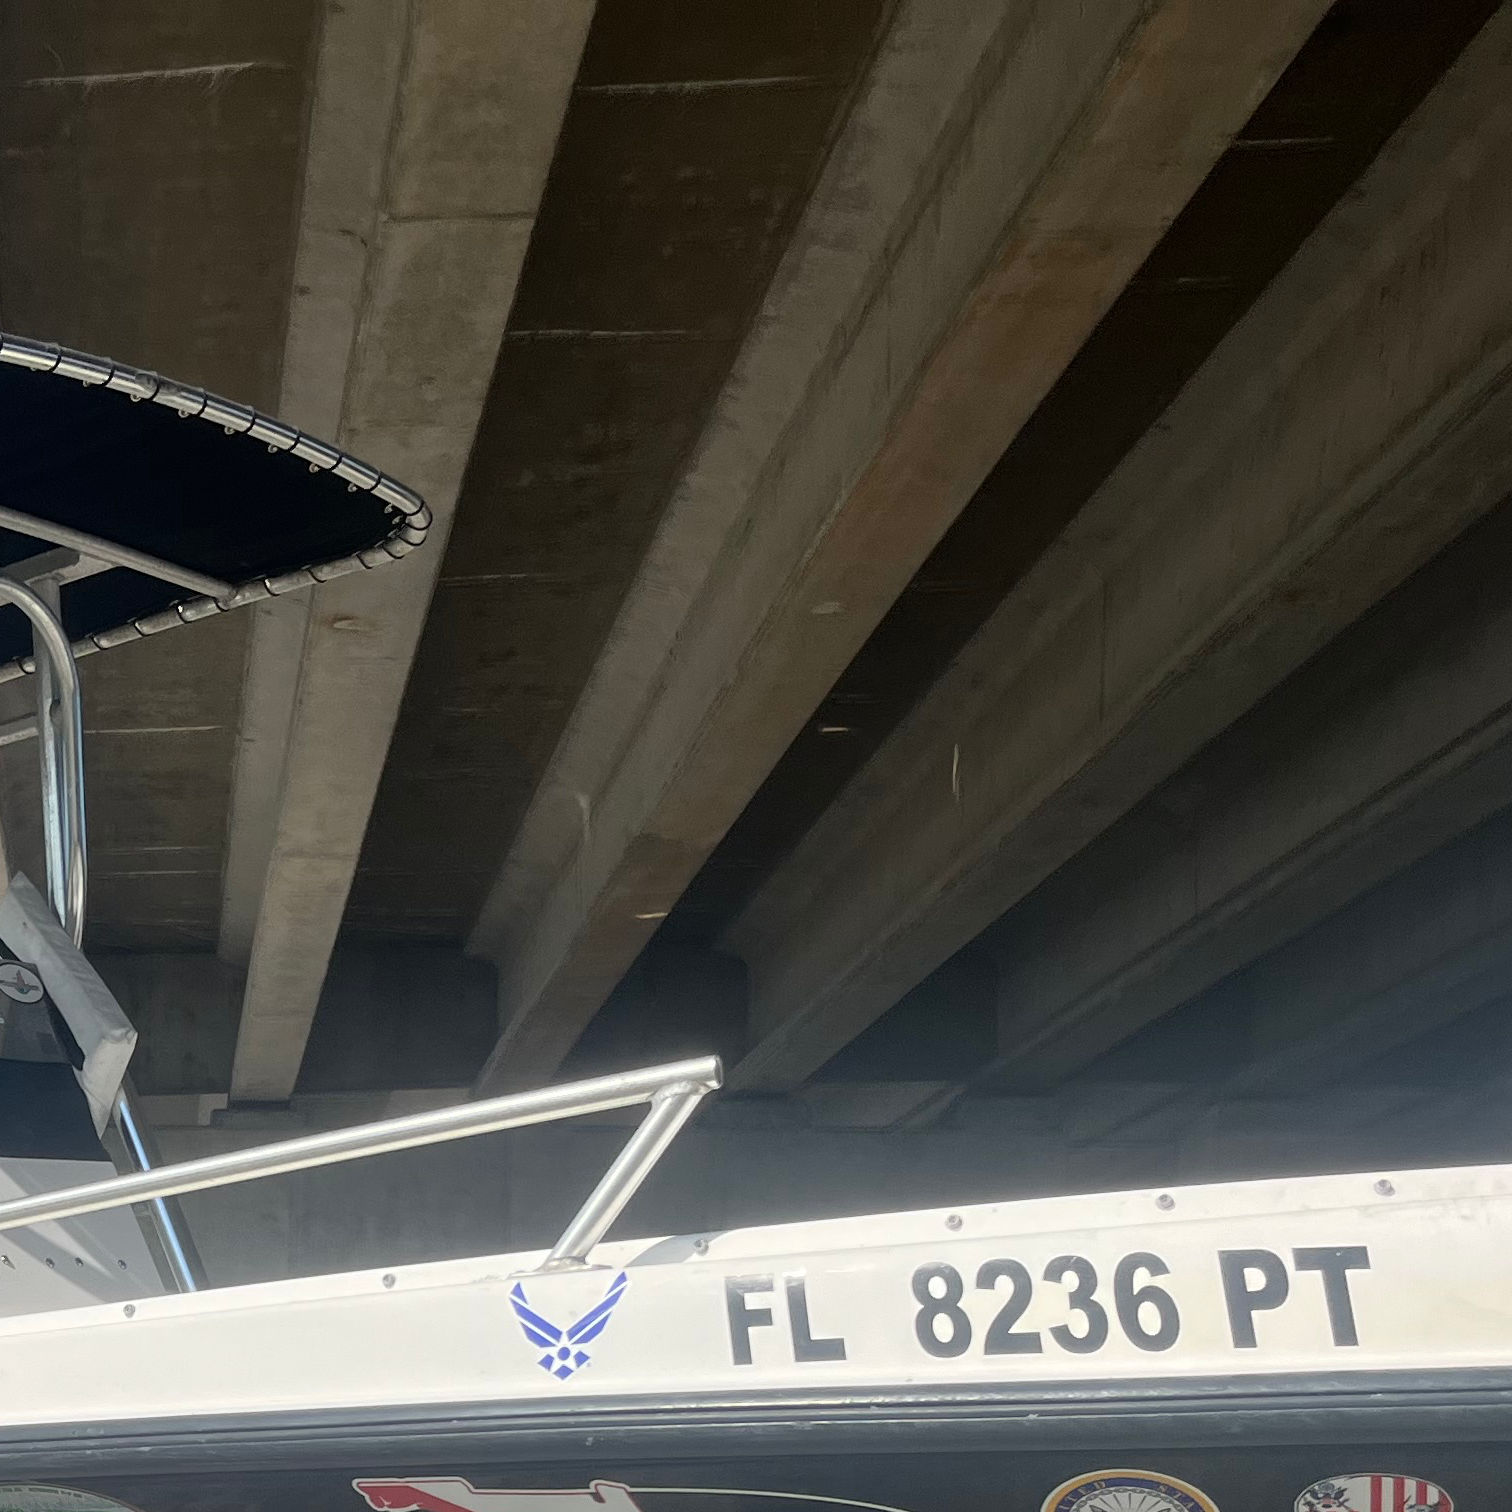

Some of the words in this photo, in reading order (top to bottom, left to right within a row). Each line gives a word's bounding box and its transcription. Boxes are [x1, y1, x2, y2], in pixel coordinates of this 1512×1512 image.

[723, 1275, 847, 1367] FL
[909, 1252, 1182, 1359] 8236
[1217, 1245, 1371, 1350] PT
